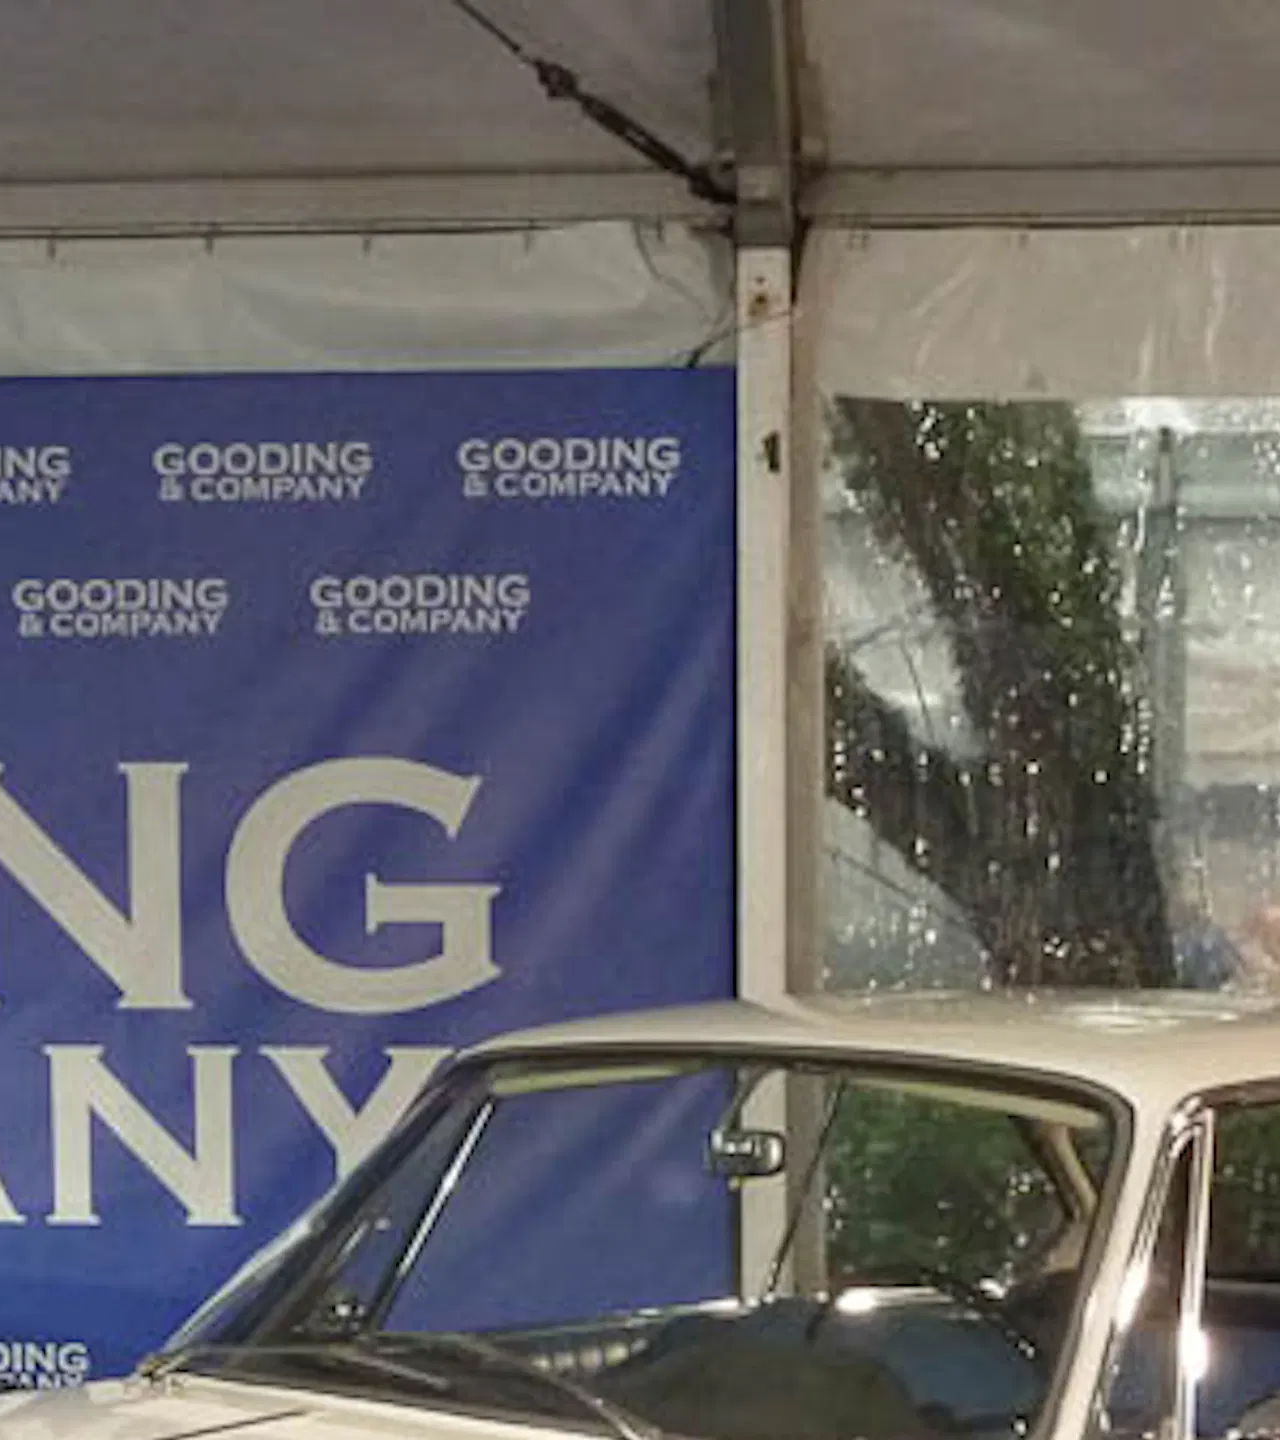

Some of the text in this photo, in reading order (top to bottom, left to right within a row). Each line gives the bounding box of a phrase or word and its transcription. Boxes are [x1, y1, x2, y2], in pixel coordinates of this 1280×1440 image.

[152, 441, 374, 475] GOODING
[457, 436, 682, 471] GOODING
[159, 475, 367, 501] & COMPANY
[463, 470, 675, 497] & COMPANY
[11, 577, 230, 611] GOODING
[309, 574, 532, 608] GOODING
[18, 610, 224, 637] & COMPANY
[315, 607, 526, 634] & COMPANY
